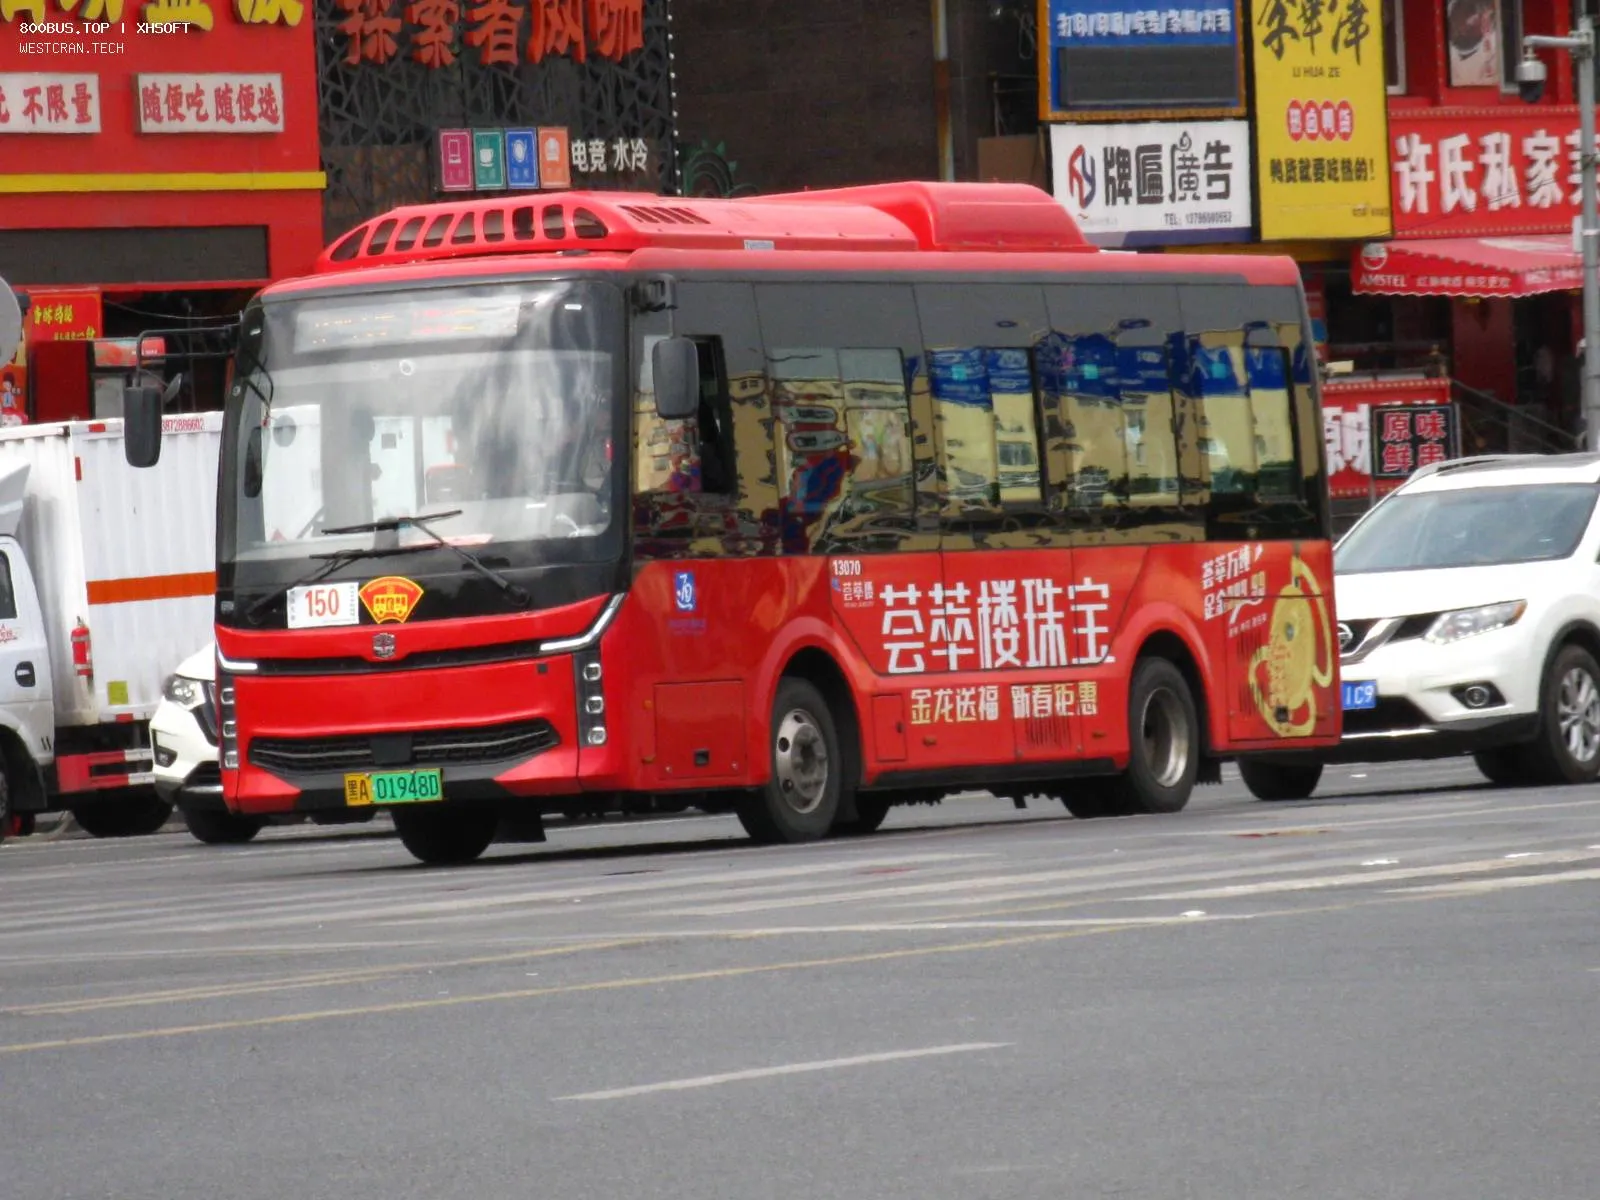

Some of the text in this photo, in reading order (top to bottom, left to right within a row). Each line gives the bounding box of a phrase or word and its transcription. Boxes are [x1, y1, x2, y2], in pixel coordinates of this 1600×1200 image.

[22, 83, 92, 124] 不限量
[571, 138, 649, 171] 电竞 水冷
[1360, 273, 1407, 287] AMSTEL
[1382, 411, 1446, 441] 原味
[832, 559, 862, 576] 13070
[305, 588, 340, 617] 150
[879, 577, 1116, 674] 荟萃楼珠宝
[911, 685, 999, 725] 金龙送福
